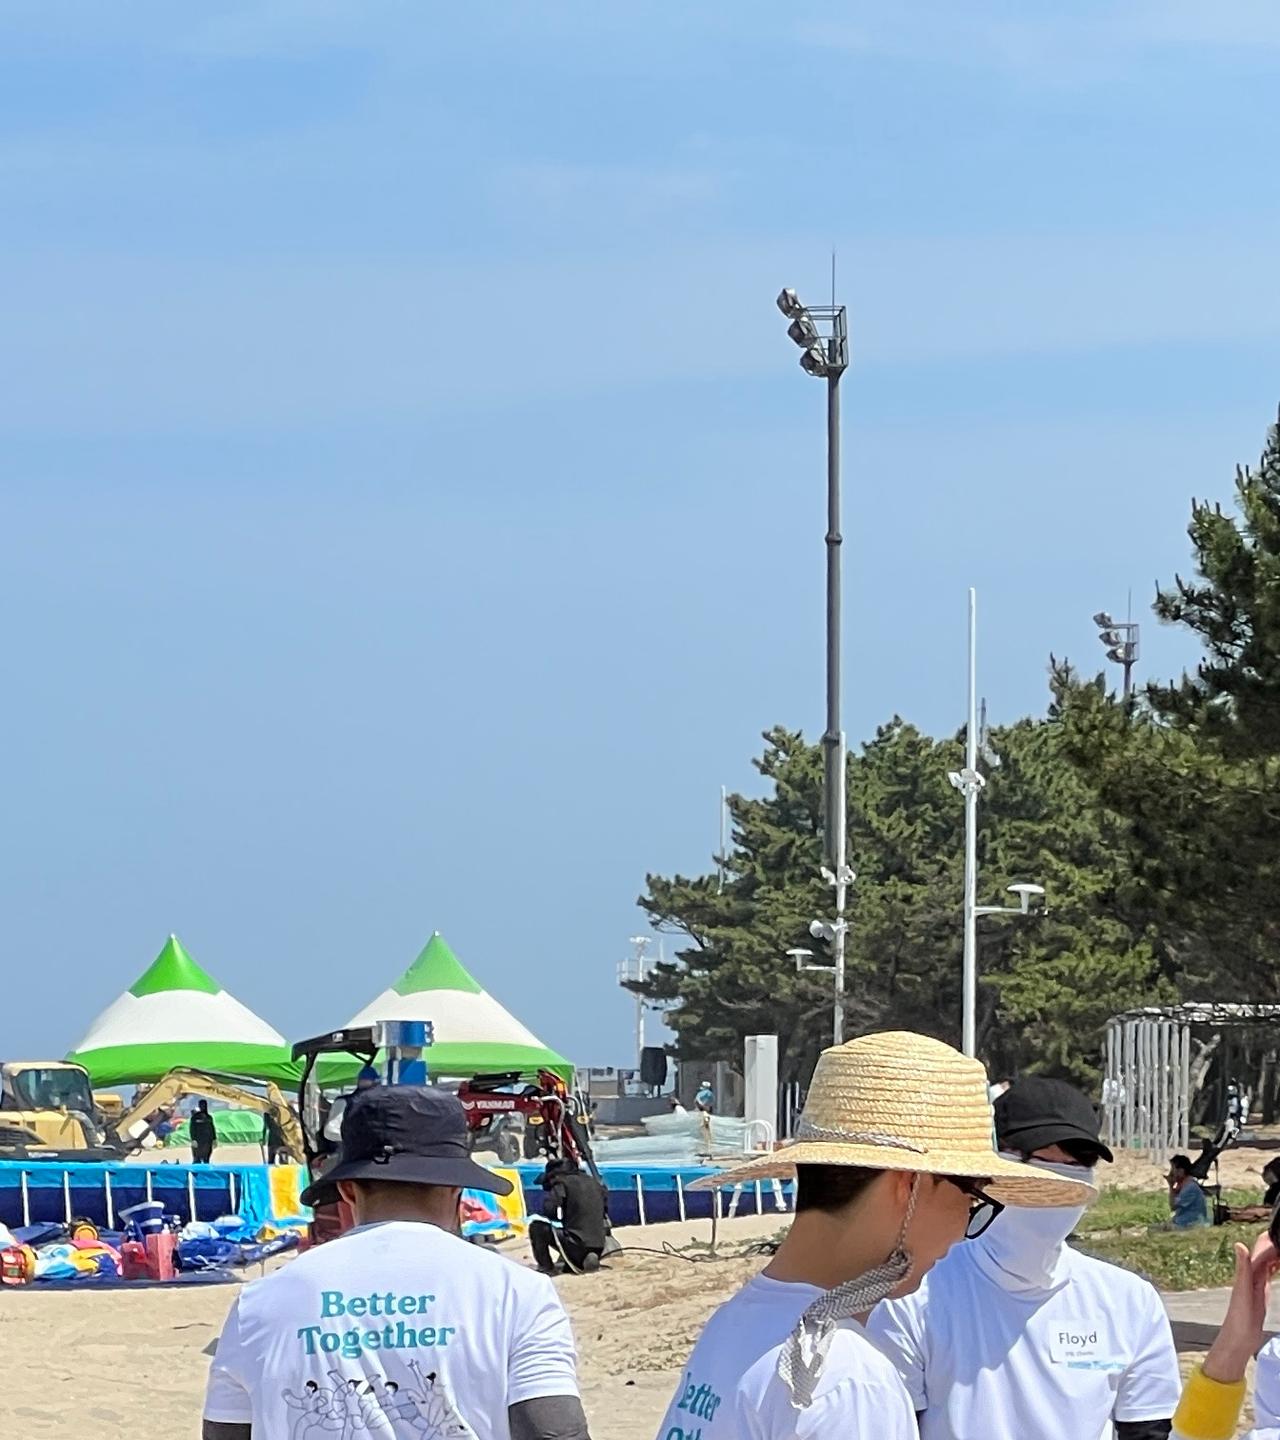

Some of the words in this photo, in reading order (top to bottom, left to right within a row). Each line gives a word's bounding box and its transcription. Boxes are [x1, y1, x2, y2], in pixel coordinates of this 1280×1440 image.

[476, 1100, 516, 1110] YANMAR
[320, 1290, 436, 1318] Better
[297, 1321, 456, 1359] Together
[1058, 1330, 1098, 1348] Floyd
